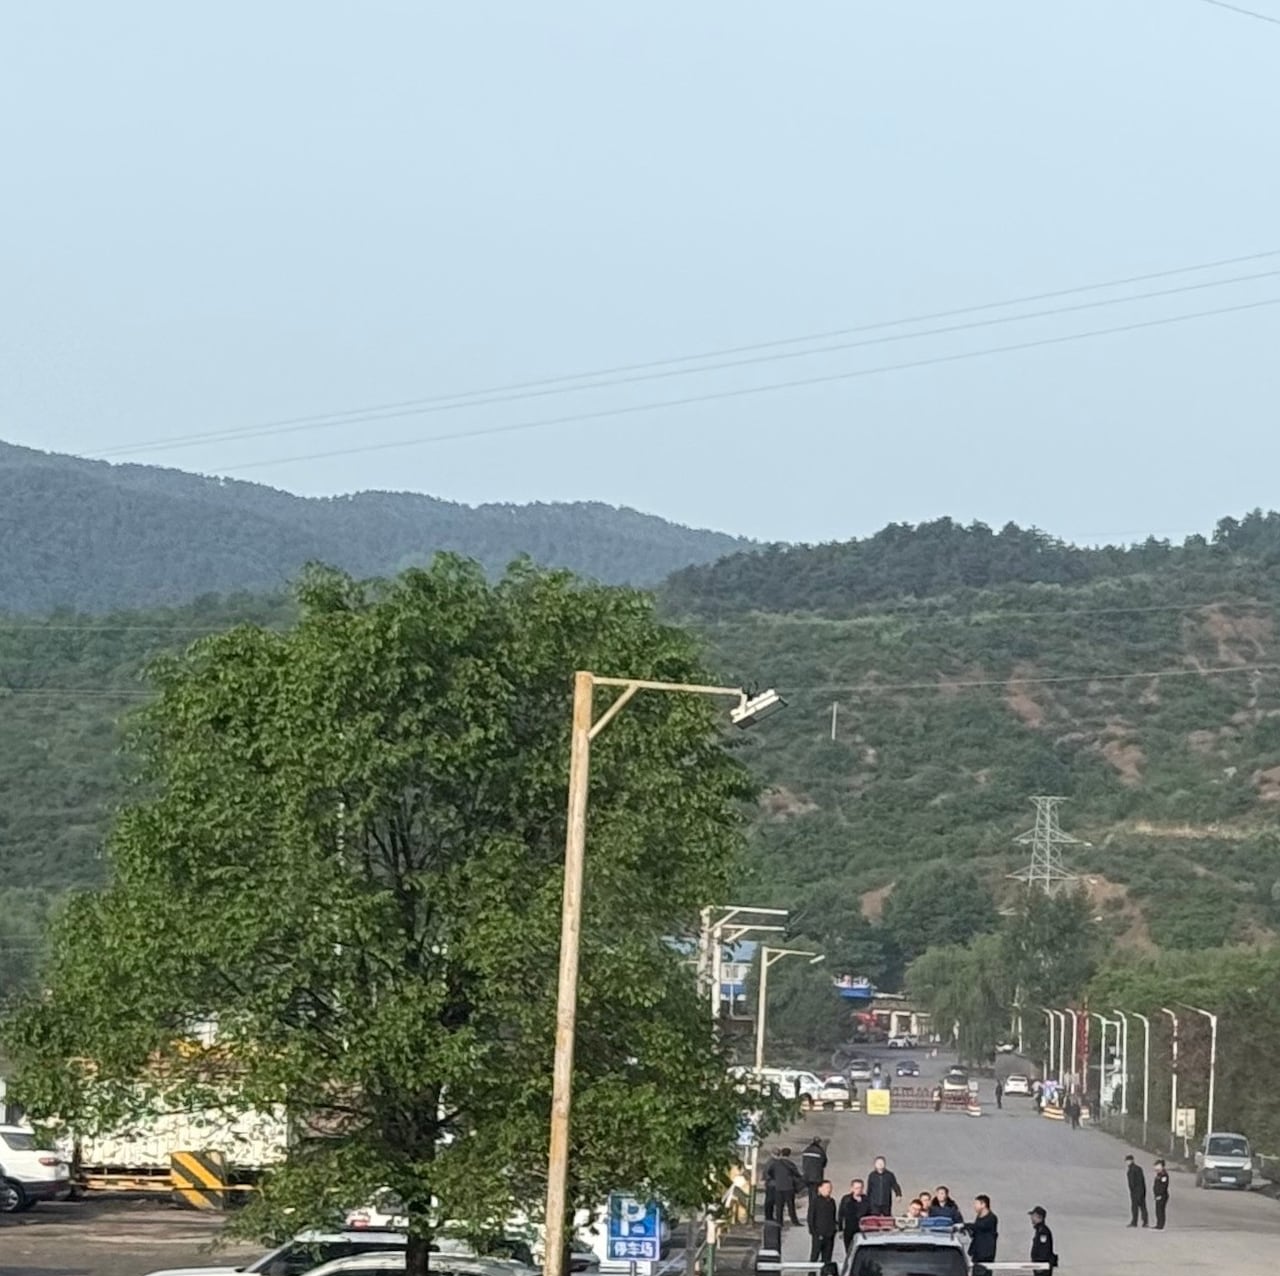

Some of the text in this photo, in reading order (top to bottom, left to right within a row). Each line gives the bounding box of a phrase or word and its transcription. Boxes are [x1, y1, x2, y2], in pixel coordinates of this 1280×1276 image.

[620, 1198, 646, 1236] P
[614, 1241, 653, 1257] 停车场
